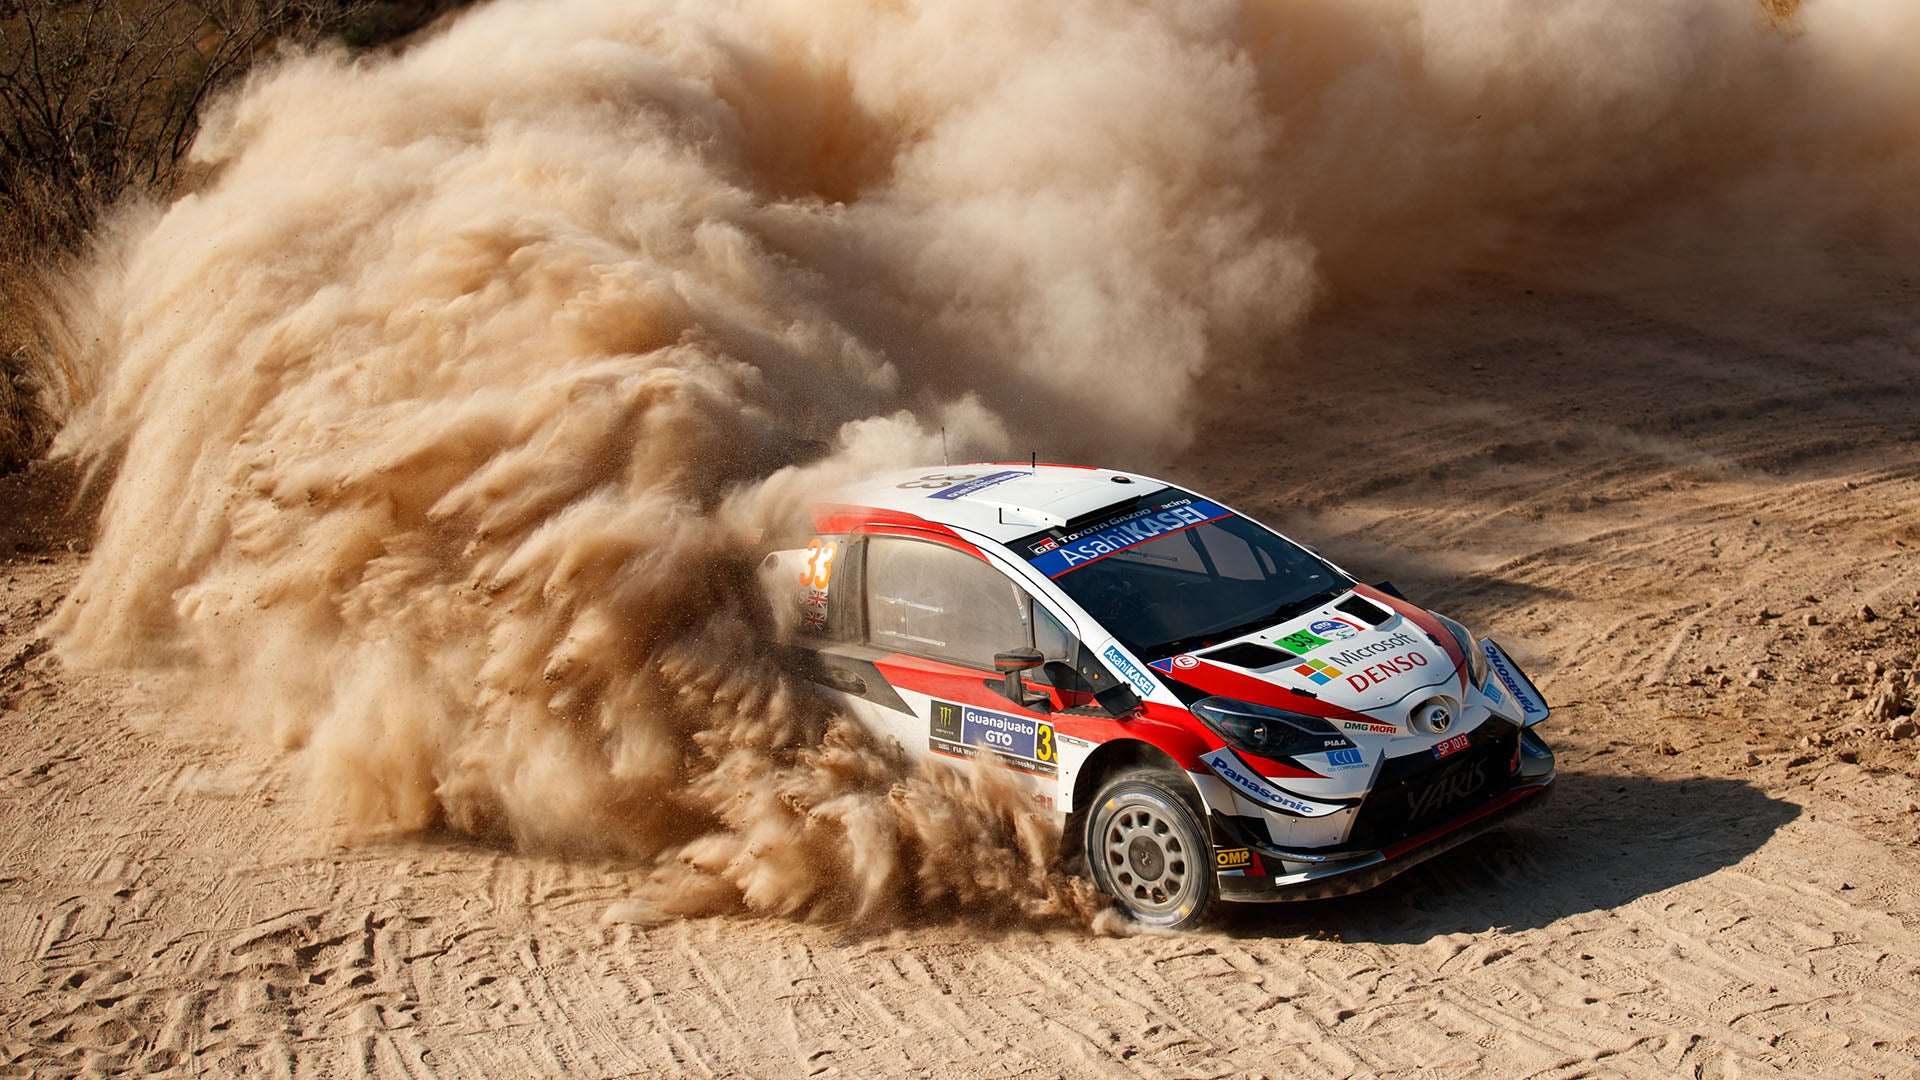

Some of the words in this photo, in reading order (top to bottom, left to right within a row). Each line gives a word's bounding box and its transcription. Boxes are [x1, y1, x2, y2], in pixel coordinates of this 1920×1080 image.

[1058, 522, 1110, 543] TOYOTA
[1109, 508, 1151, 526] GAZOO
[1151, 498, 1192, 514] Racing
[1059, 506, 1209, 567] AsahiKASEI
[799, 538, 838, 590] 33
[1283, 632, 1315, 648] 33
[1329, 633, 1418, 667] Microsoft
[1105, 647, 1154, 695] AsahiKASEI
[1346, 651, 1429, 694] DENSO
[1485, 645, 1543, 714] Panasonic
[966, 711, 1034, 736] Guanajuato
[985, 729, 1013, 746] GTO
[1344, 722, 1369, 732] DMG
[1369, 725, 1397, 734] MORI
[1324, 739, 1348, 747] PIAA
[1437, 743, 1450, 756] SP
[1451, 735, 1469, 750] 1013
[1211, 756, 1315, 814] Panasonic
[1217, 850, 1251, 865] OMP
